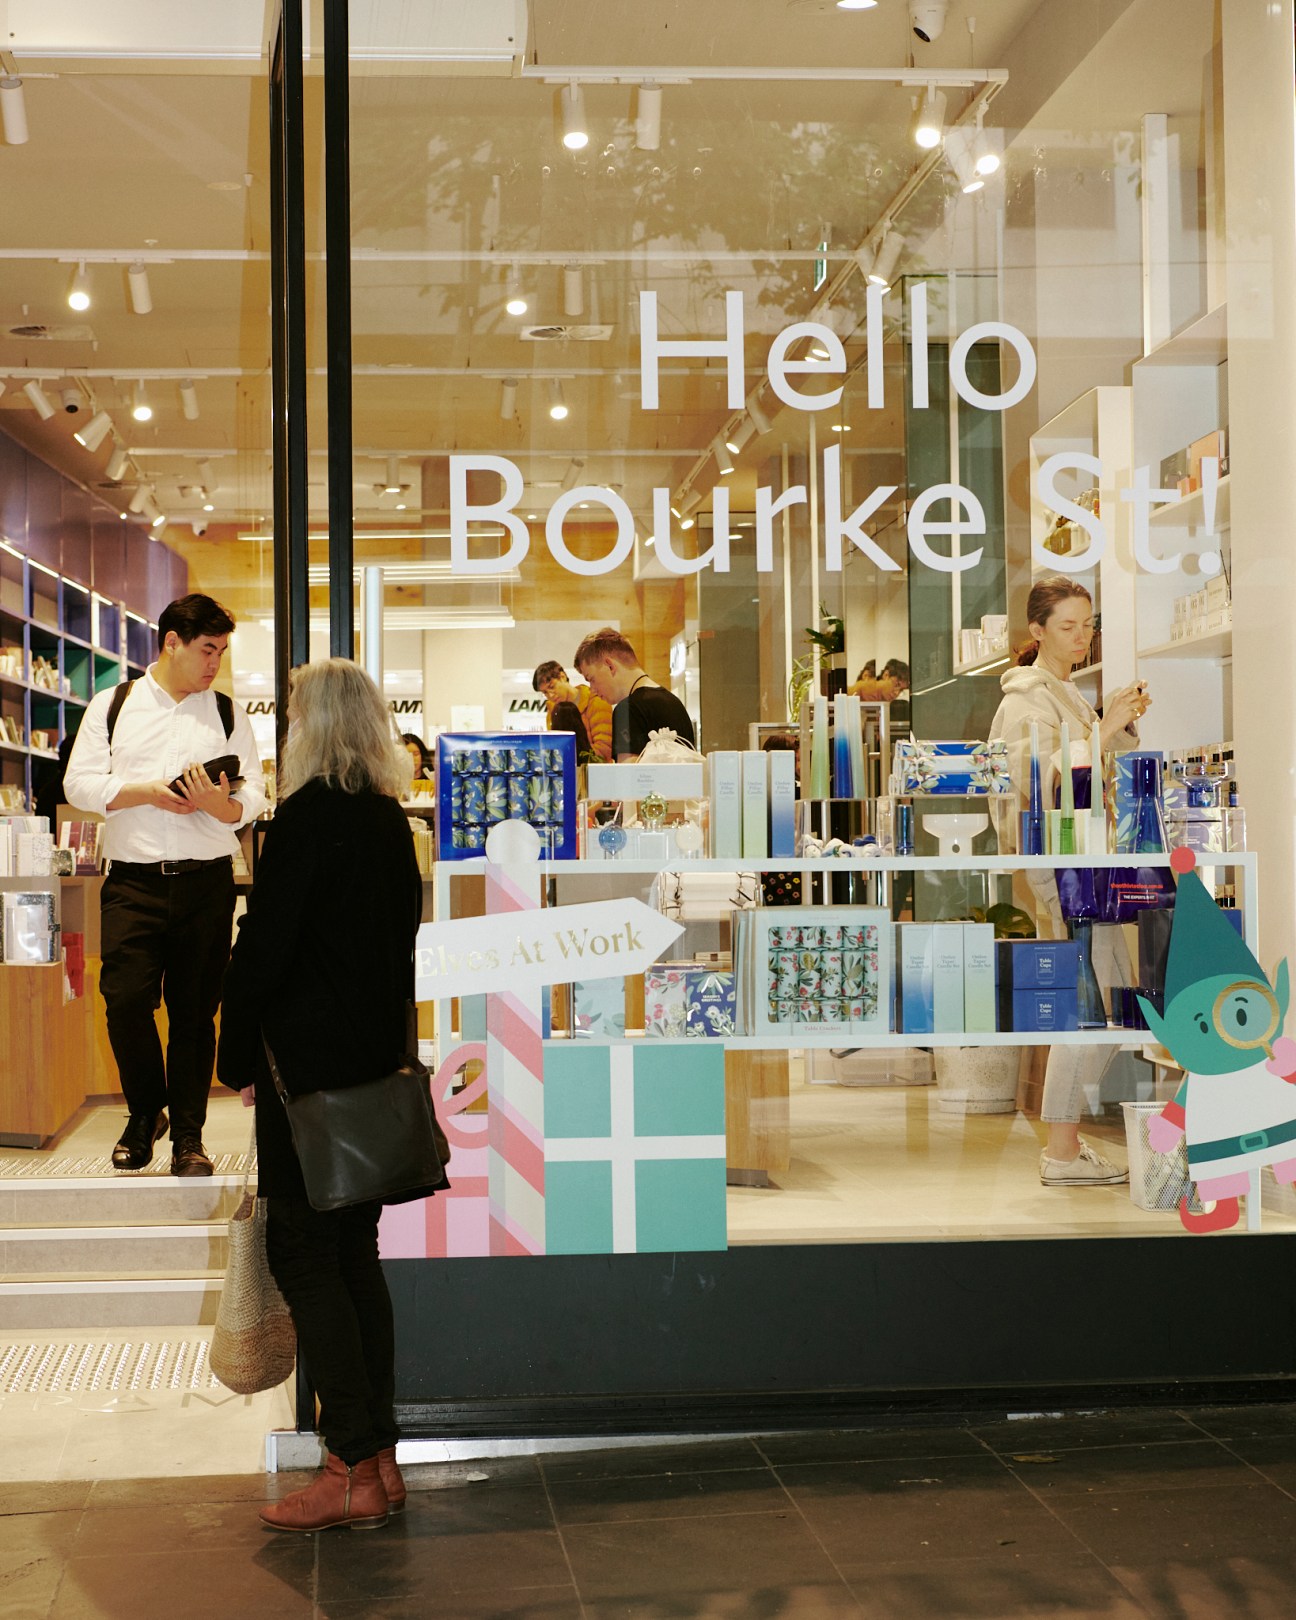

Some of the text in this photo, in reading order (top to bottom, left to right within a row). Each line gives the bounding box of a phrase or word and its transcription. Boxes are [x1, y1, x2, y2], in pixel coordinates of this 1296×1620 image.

[638, 281, 1037, 411] Hello
[449, 443, 1222, 576] Bourke St!
[415, 921, 645, 979] Elves At Work
